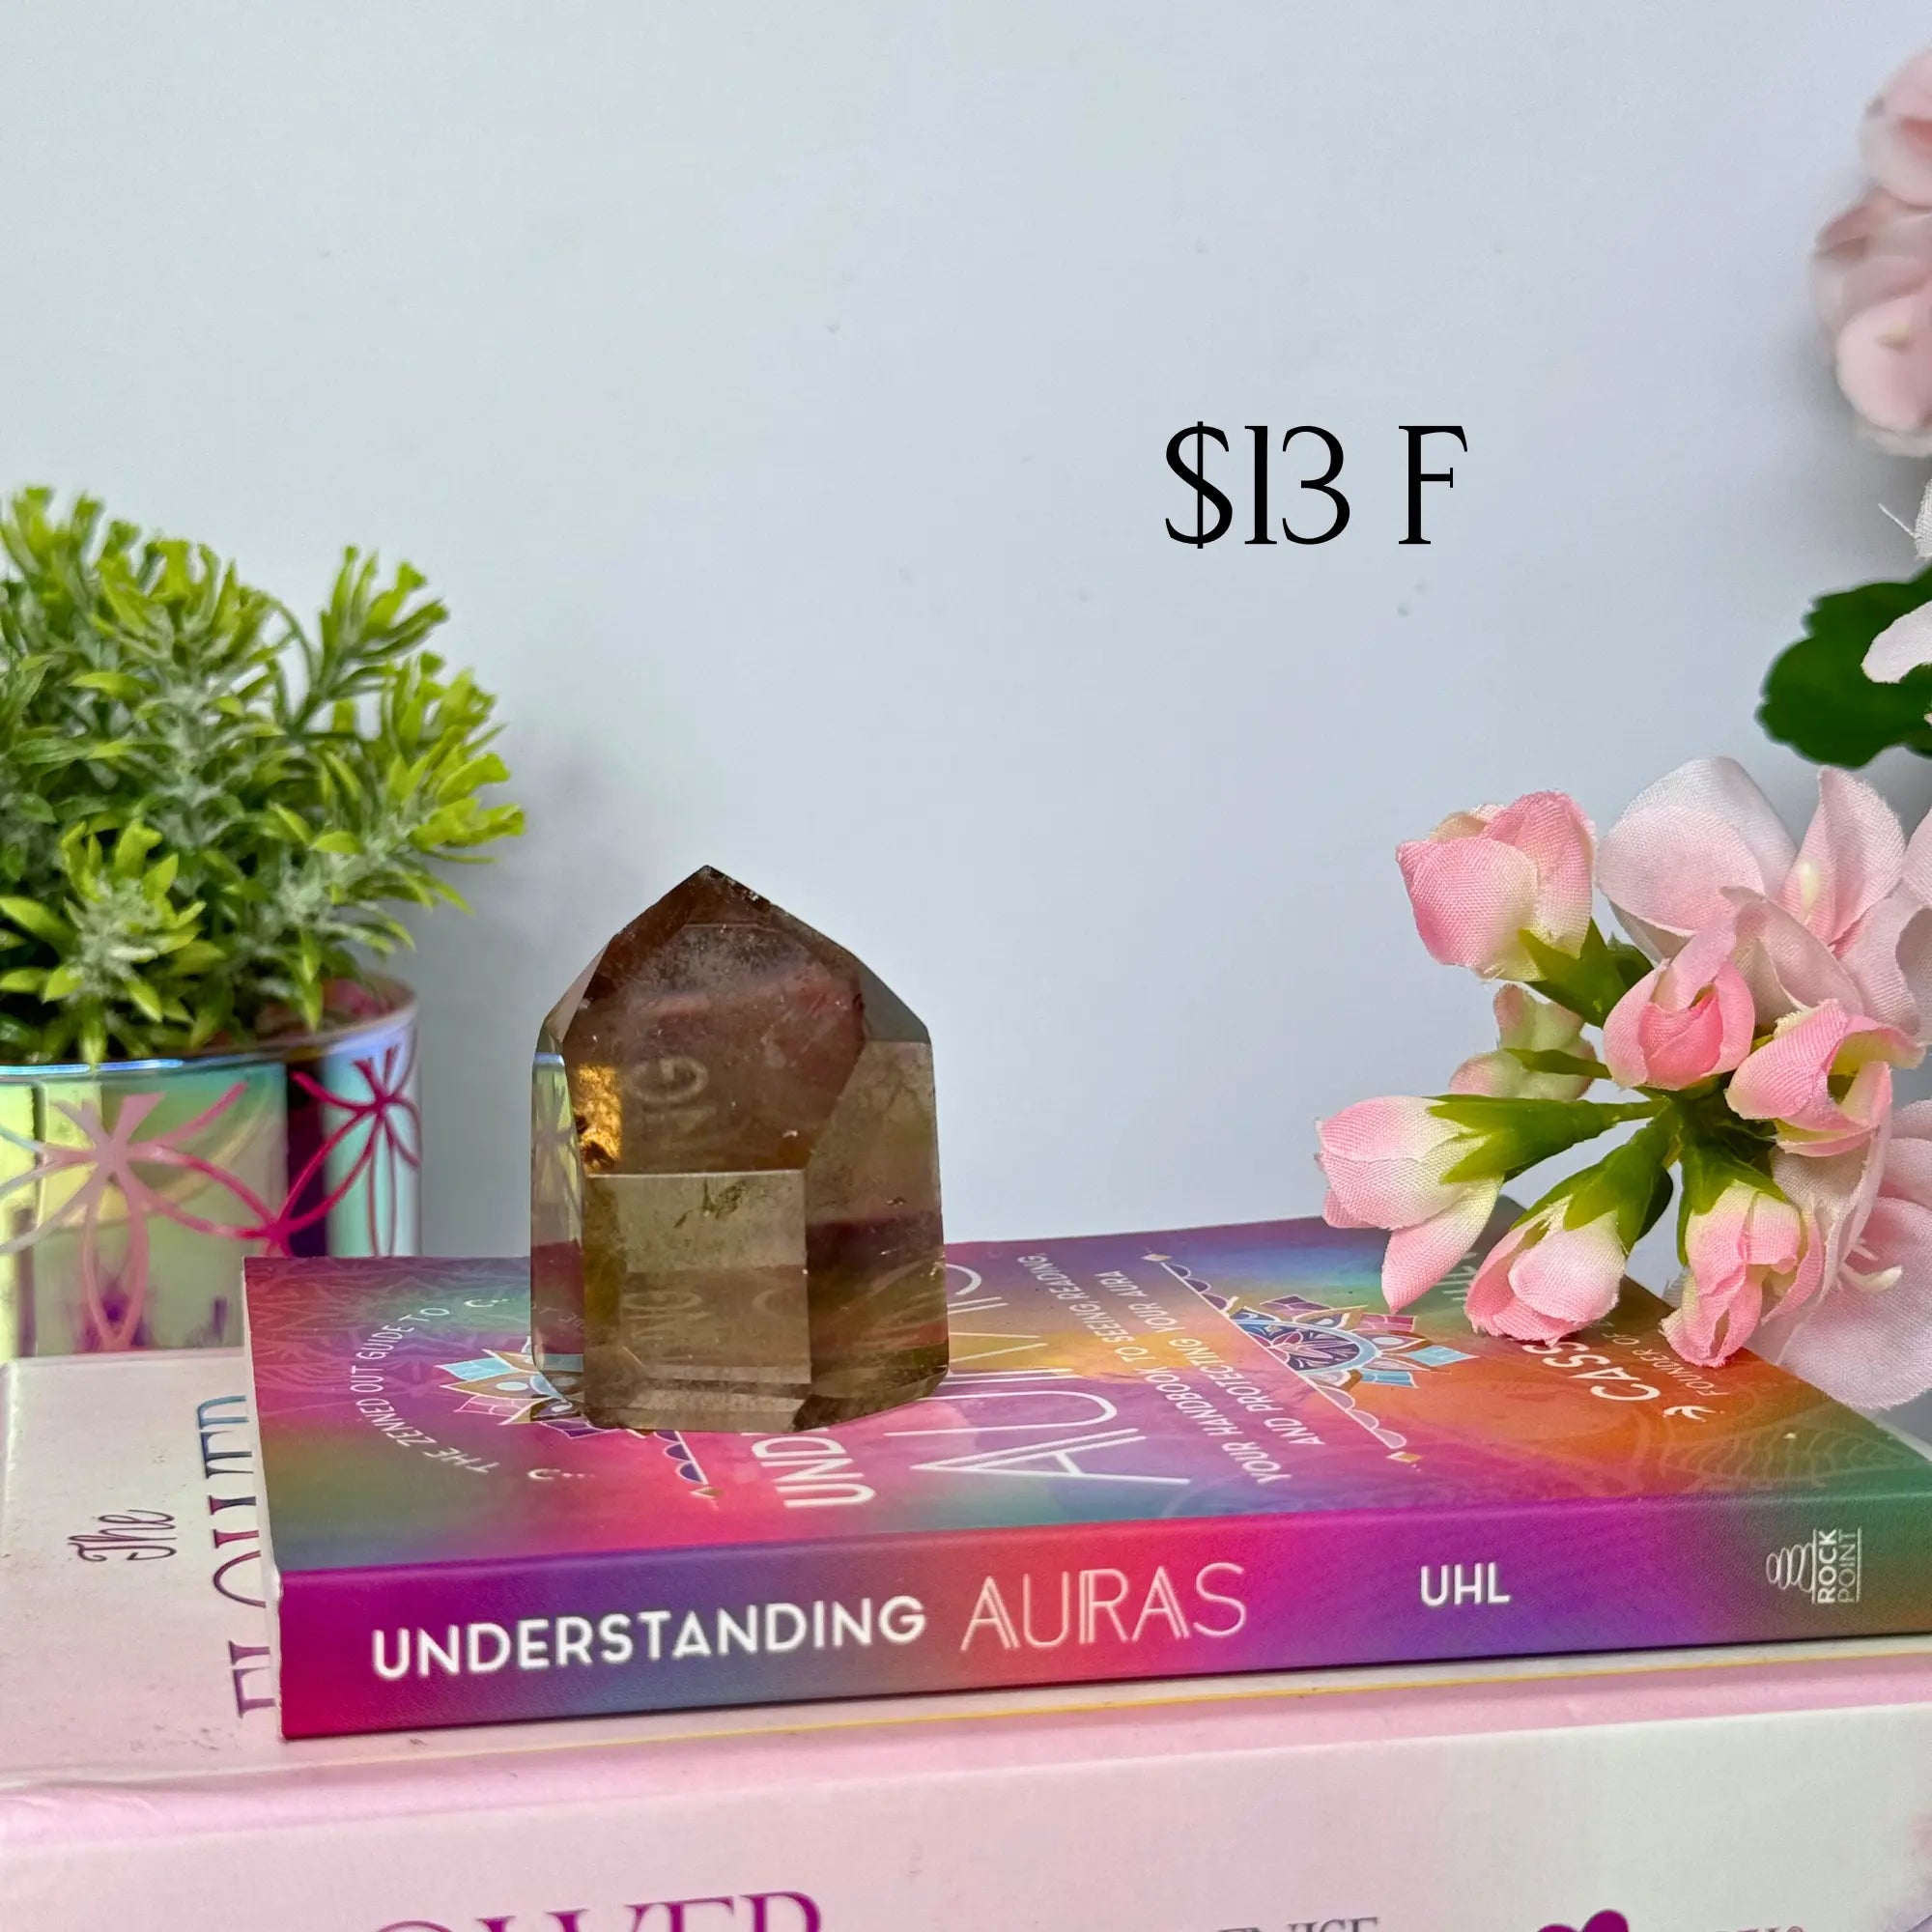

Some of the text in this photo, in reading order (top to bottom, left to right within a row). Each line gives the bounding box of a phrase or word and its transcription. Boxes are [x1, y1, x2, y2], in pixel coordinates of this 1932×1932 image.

[350, 1307, 500, 1473] THE ZENNED OUT GUIDE TO
[1017, 1253, 1292, 1484] YOUR HANDBOOK TO SEEING, READING,
[1094, 1269, 1326, 1446] AND PROTECTING YOUR AURA
[1522, 1342, 1661, 1401] CASS
[1601, 1332, 1730, 1396] FOUNDER OF
[68, 1509, 177, 1562] The
[1817, 1528, 1837, 1604] ROCK
[1837, 1528, 1857, 1603] POINT
[371, 1562, 1247, 1681] UNDERSTANDING AURAS
[1419, 1561, 1512, 1607] UHL
